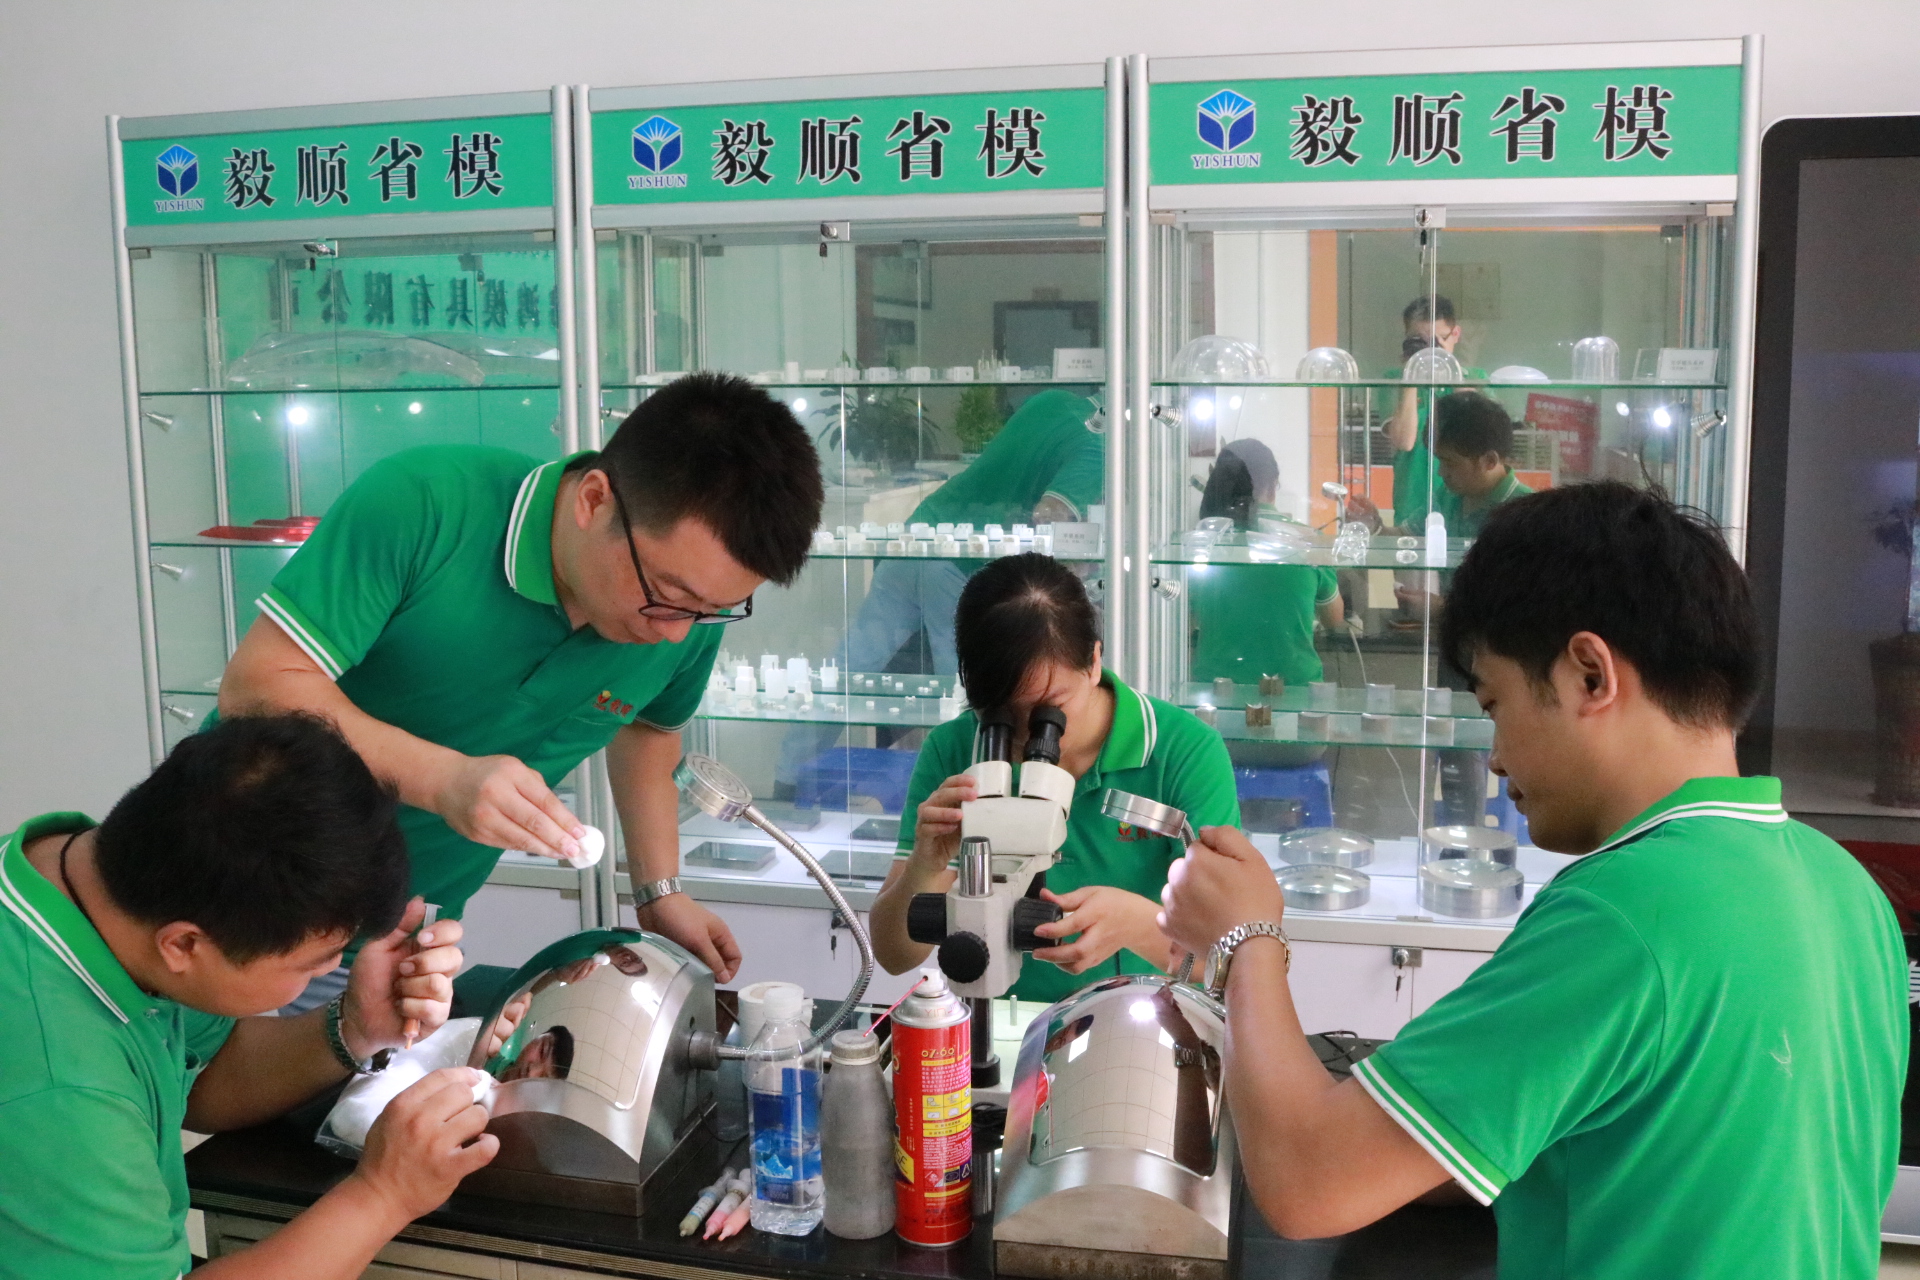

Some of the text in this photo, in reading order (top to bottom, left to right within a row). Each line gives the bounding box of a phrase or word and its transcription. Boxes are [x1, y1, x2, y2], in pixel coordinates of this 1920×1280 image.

[712, 108, 1047, 187] 毅顺省模
[1290, 86, 1674, 166] 毅顺省模
[223, 133, 505, 208] 毅顺省模
[628, 174, 687, 189] YISHUN
[1192, 153, 1261, 169] YISHUN
[155, 198, 205, 212] YISHUN
